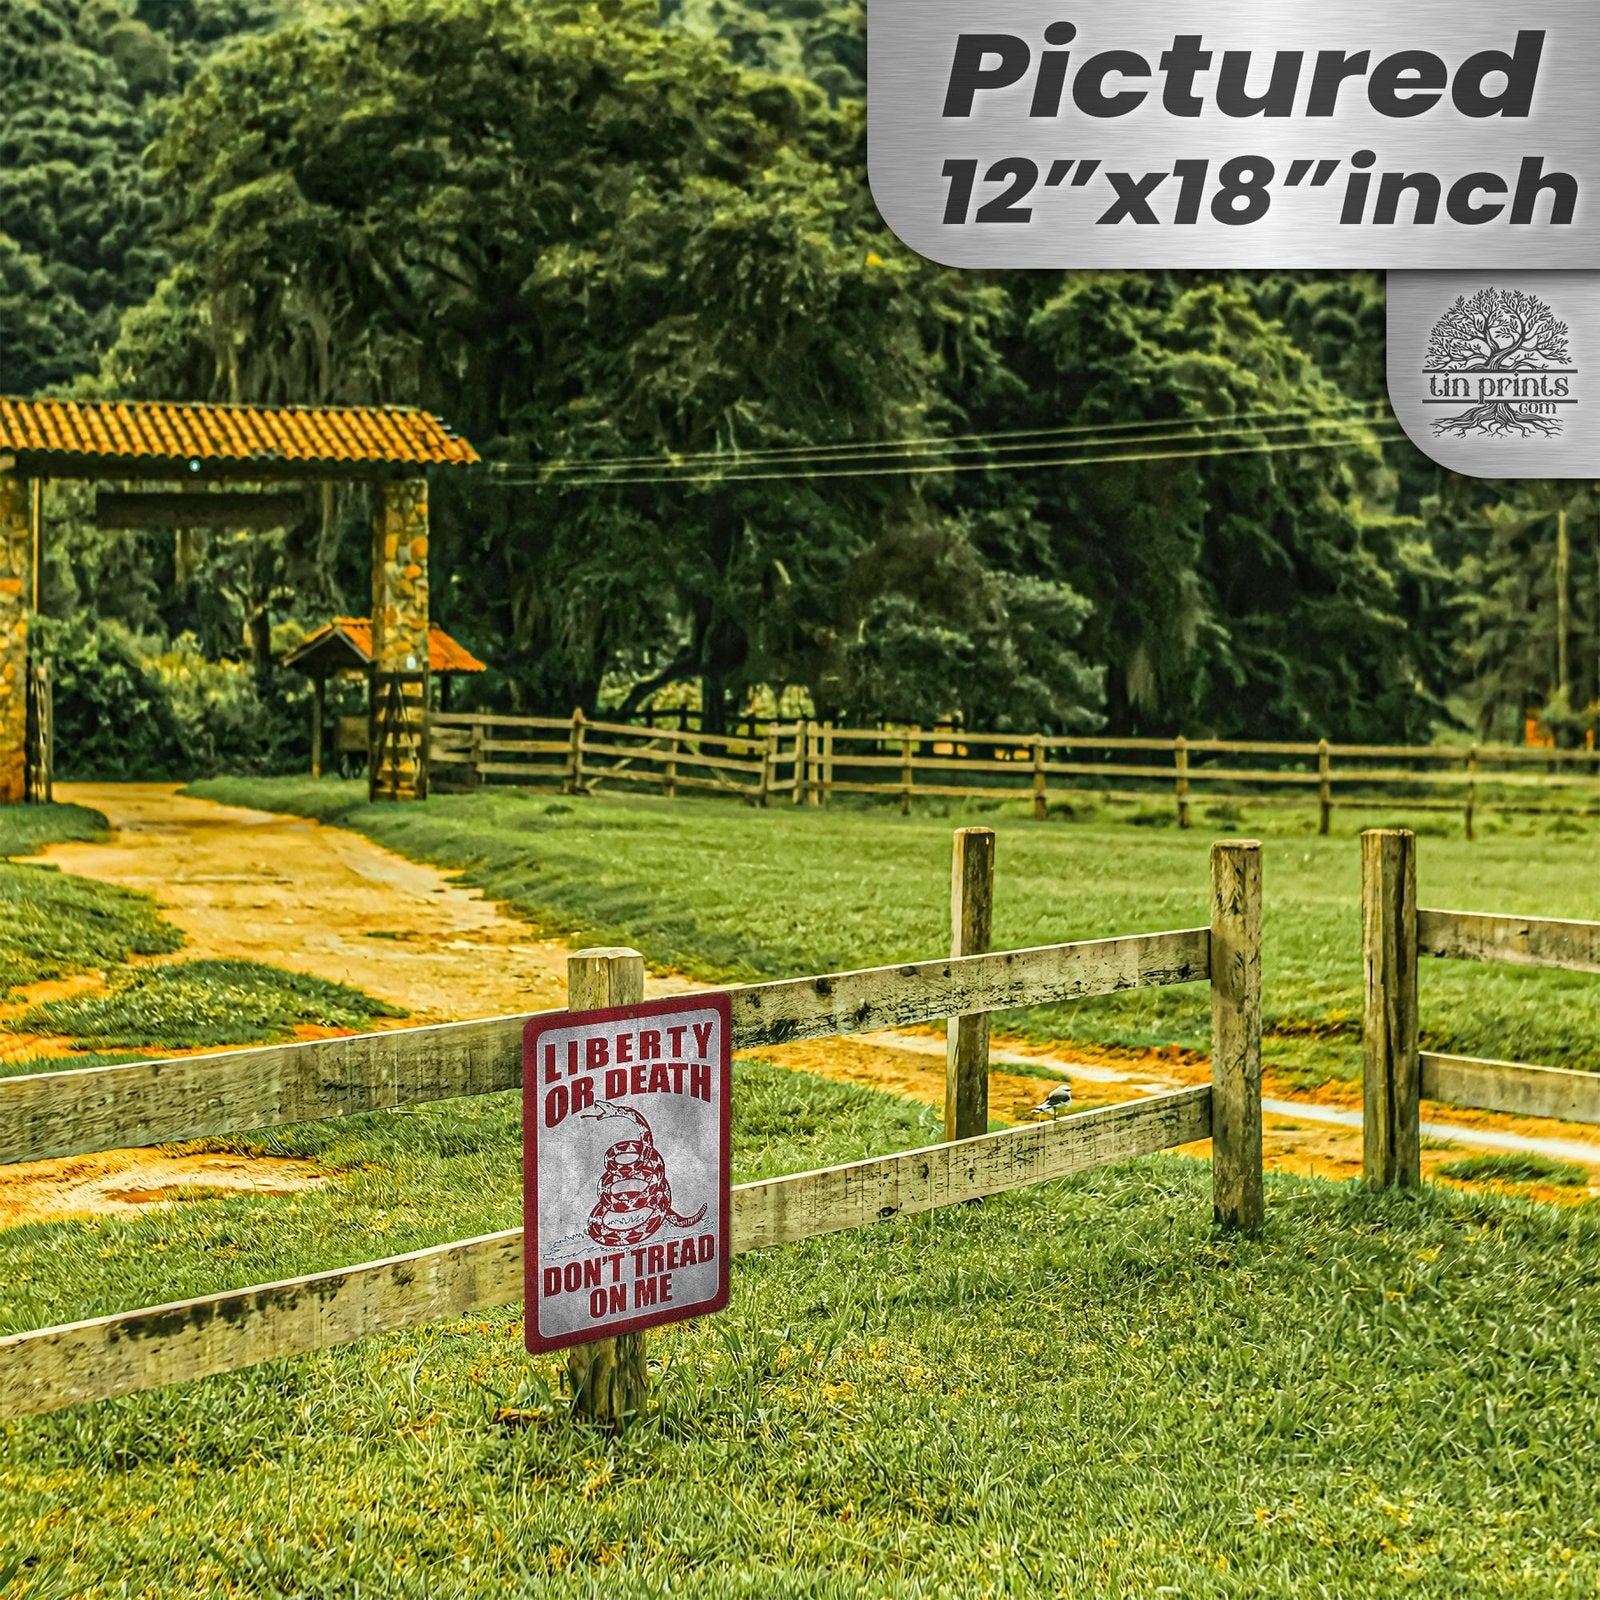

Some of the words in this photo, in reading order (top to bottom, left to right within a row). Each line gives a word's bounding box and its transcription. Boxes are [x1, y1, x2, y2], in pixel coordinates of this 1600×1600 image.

[544, 1021, 713, 1085] LIBERTY
[544, 1075, 597, 1129] OR
[605, 1062, 711, 1103] DEATH
[543, 1248, 623, 1297] DON'T
[631, 1234, 715, 1276] TREAD
[589, 1282, 627, 1319] ON
[635, 1272, 672, 1307] ME
